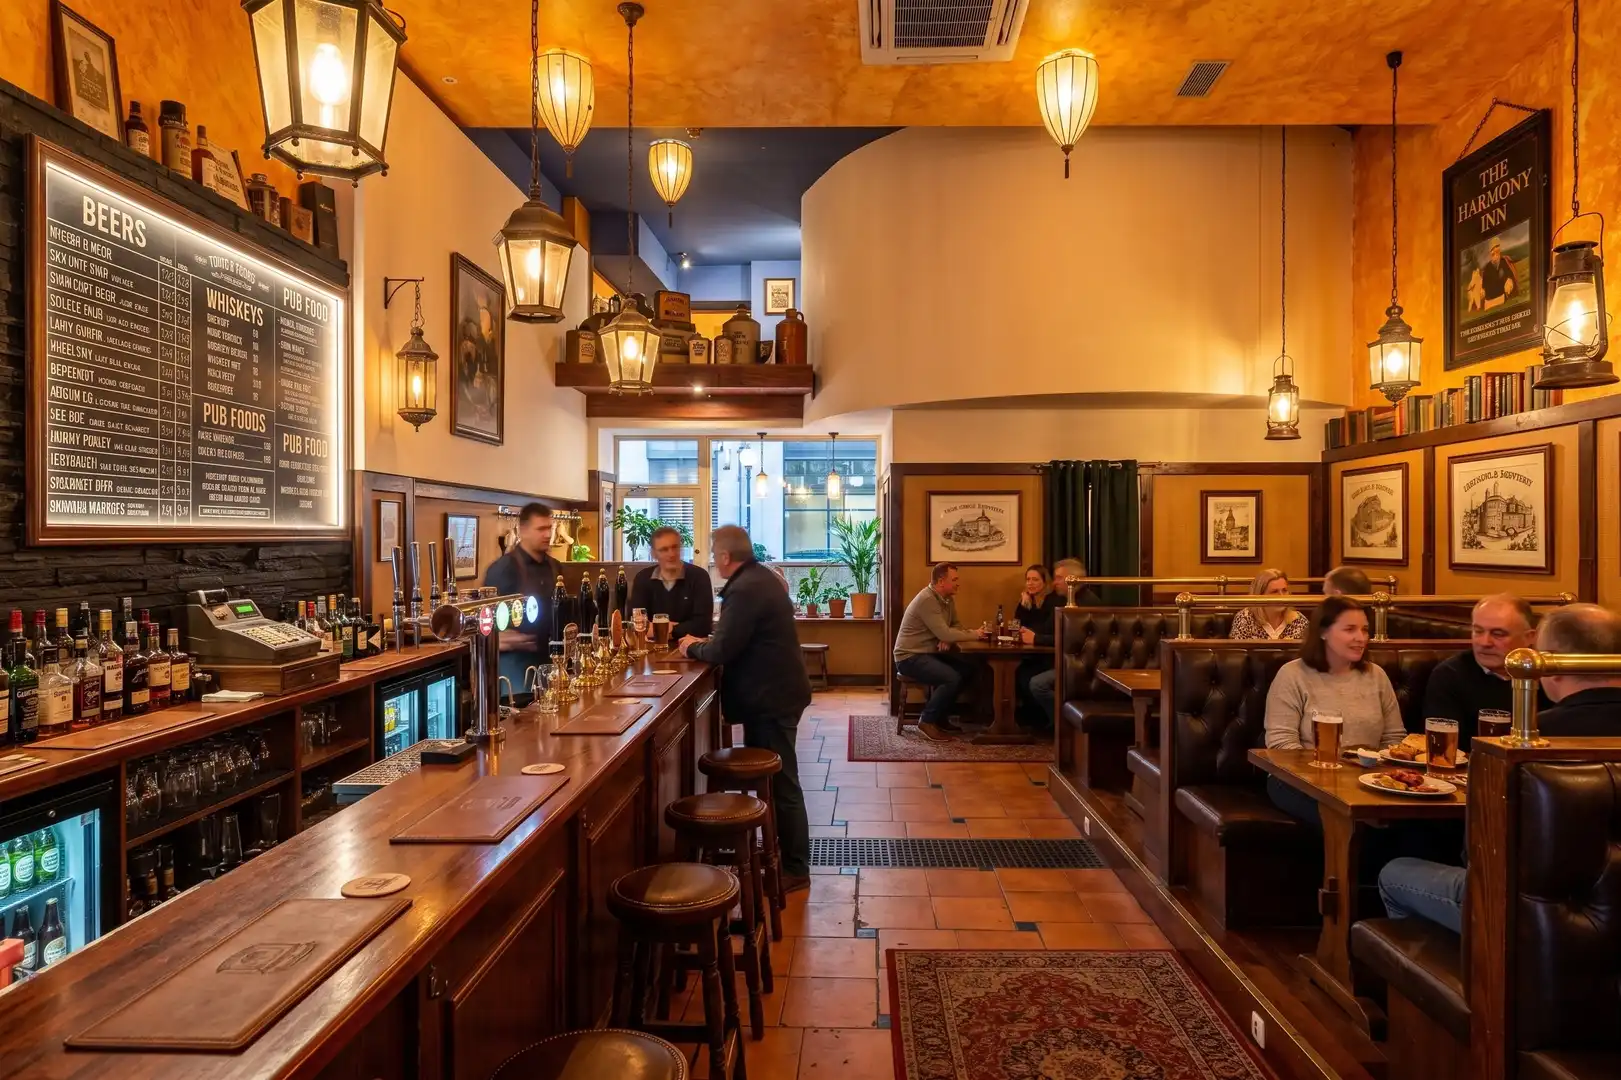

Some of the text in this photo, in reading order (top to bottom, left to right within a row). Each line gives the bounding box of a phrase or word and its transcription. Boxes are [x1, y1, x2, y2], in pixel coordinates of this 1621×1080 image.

[1479, 158, 1509, 189] THE
[1457, 167, 1533, 224] HARMONY
[82, 195, 147, 248] BEERS
[1480, 204, 1507, 233] INN
[206, 287, 264, 326] WHISKEYS
[283, 287, 302, 312] PUB
[305, 298, 328, 322] FOOD
[50, 408, 67, 422] SEE
[203, 402, 227, 427] PUB
[231, 408, 266, 433] FOODS
[283, 433, 328, 458] PUB FOOD
